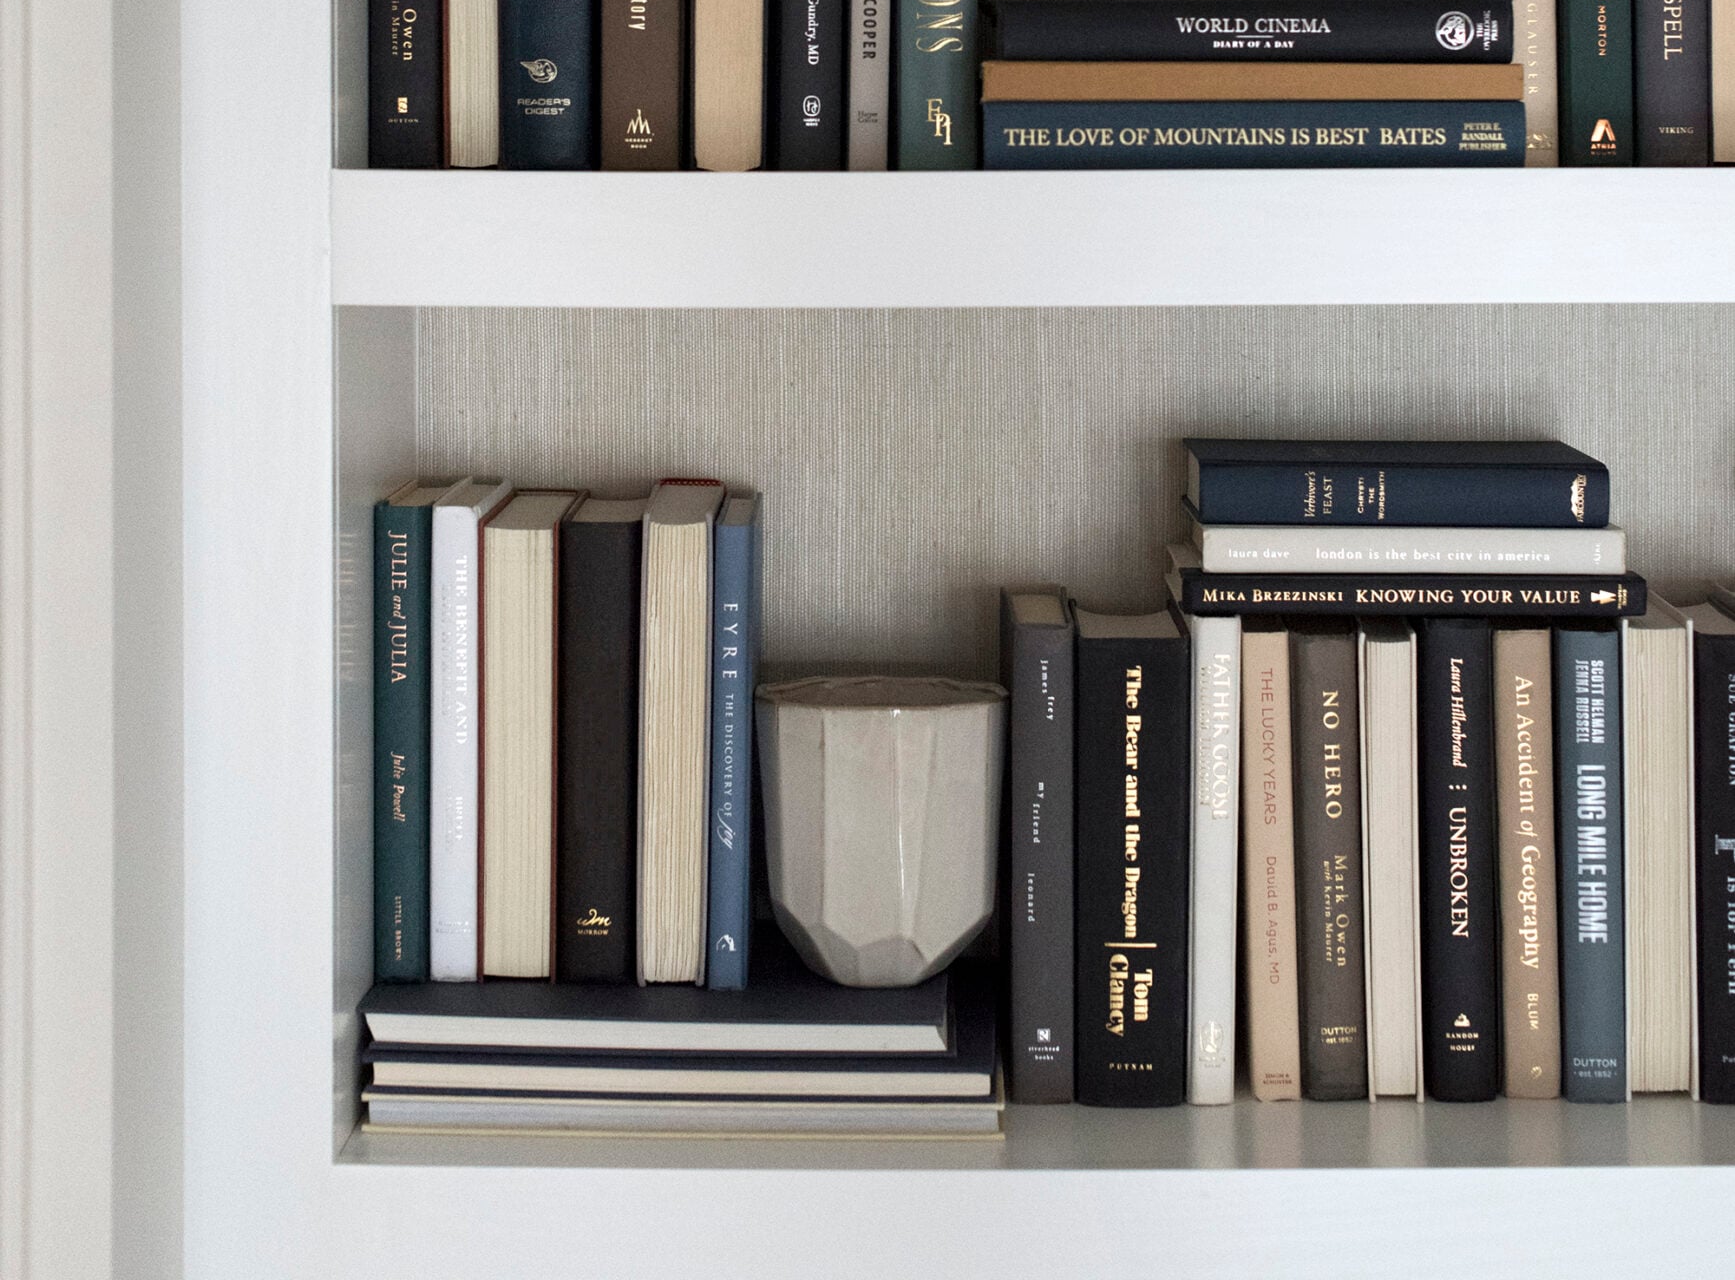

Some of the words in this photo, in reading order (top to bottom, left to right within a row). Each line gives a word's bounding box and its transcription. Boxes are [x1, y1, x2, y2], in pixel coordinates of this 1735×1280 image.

[391, 16, 401, 56] Maurer
[402, 8, 418, 61] Owen
[1176, 17, 1249, 33] WORLD
[1255, 18, 1331, 33] CINEMA
[1213, 40, 1244, 48] DIARY
[1247, 40, 1261, 48] OF
[1264, 40, 1271, 48] A
[1274, 40, 1295, 48] DAY
[1598, 5, 1607, 56] MORTON
[807, 44, 819, 65] MD
[1527, 3, 1539, 95] GLAUSER
[517, 98, 571, 106] READER'S
[524, 107, 566, 116] DIGEST
[1003, 128, 1050, 146] THE
[1055, 128, 1113, 146] LOVE
[1119, 128, 1149, 146] OF
[1153, 127, 1285, 145] MOUNTAINS
[1290, 127, 1308, 145] IS
[1316, 127, 1369, 145] BEST
[1380, 127, 1446, 145] BATES
[1461, 132, 1504, 140] RANDALL
[1463, 122, 1492, 130] PETER
[1493, 122, 1502, 130] E.
[1658, 126, 1695, 134] VIKING
[1304, 471, 1316, 518] Verbivore's
[1323, 476, 1333, 515] FEAST
[387, 530, 407, 591] JULIE
[1228, 548, 1258, 559] laura
[1263, 548, 1290, 559] dave
[1315, 548, 1363, 560] london
[1368, 549, 1380, 560] is
[1385, 549, 1407, 561] the
[1413, 549, 1441, 561] best
[1447, 550, 1473, 562] city
[1478, 550, 1492, 561] in
[1497, 550, 1550, 562] america
[455, 554, 468, 597] THE
[392, 595, 406, 620] and
[1203, 589, 1246, 603] MIKA
[1252, 589, 1343, 603] BRZEZINSKI
[1356, 589, 1454, 603] KNOWING
[1461, 590, 1513, 604] YOUR
[1520, 590, 1580, 604] VALUE
[387, 621, 407, 684] JULIA
[455, 604, 468, 695] BENEFIT
[722, 603, 739, 679] EYRE
[1040, 659, 1049, 694] james
[1046, 696, 1055, 721] frey
[1126, 665, 1142, 709] The
[1260, 668, 1274, 703] THE
[1450, 657, 1464, 693] Laura
[1515, 675, 1533, 707] An
[1575, 659, 1590, 693] JENNA
[1591, 659, 1605, 695] SCOTT
[725, 693, 734, 718] THE
[1212, 653, 1231, 738] FATHER
[1322, 690, 1340, 729] NO
[455, 701, 468, 745] AND
[1261, 707, 1275, 765] LUCKY
[1451, 695, 1468, 768] Hillenbrand
[1576, 697, 1590, 744] RUSSELL
[1591, 698, 1605, 744] HELMAN
[723, 724, 734, 796] DISCOVERY
[1126, 715, 1142, 770] Bear
[390, 751, 405, 779] Julie
[1211, 744, 1230, 820] GOOSE
[1324, 743, 1343, 819] HERO
[1517, 713, 1538, 813] Accident
[393, 784, 405, 822] Powell
[723, 802, 733, 817] OF
[1037, 781, 1045, 799] my
[1125, 774, 1141, 818] and
[1263, 769, 1277, 825] YEARS
[1576, 764, 1606, 820] LONG
[716, 809, 736, 850] joy
[1033, 803, 1041, 843] friend
[1125, 824, 1141, 862] the
[1514, 820, 1538, 838] of
[1323, 860, 1332, 881] with
[1577, 826, 1607, 875] MILE
[1266, 856, 1278, 898] David
[1334, 854, 1349, 903] Mark
[1449, 806, 1469, 938] UNBROKEN
[1027, 873, 1035, 922] leonard
[1121, 867, 1141, 938] Dragon
[1267, 903, 1278, 916] B.
[1324, 886, 1333, 917] Kevin
[1517, 845, 1541, 969] Geography
[1578, 881, 1608, 943] HOME
[1265, 919, 1278, 958] Agus,
[1325, 922, 1334, 962] Maurer
[1336, 914, 1350, 967] Owen
[1269, 962, 1280, 985] MD
[1105, 953, 1129, 1037] Clancy
[1133, 969, 1153, 1022] Tom
[1527, 993, 1539, 1030] BLUM
[1321, 1026, 1357, 1035] DUTTON
[1573, 1057, 1617, 1068] DUTTON
